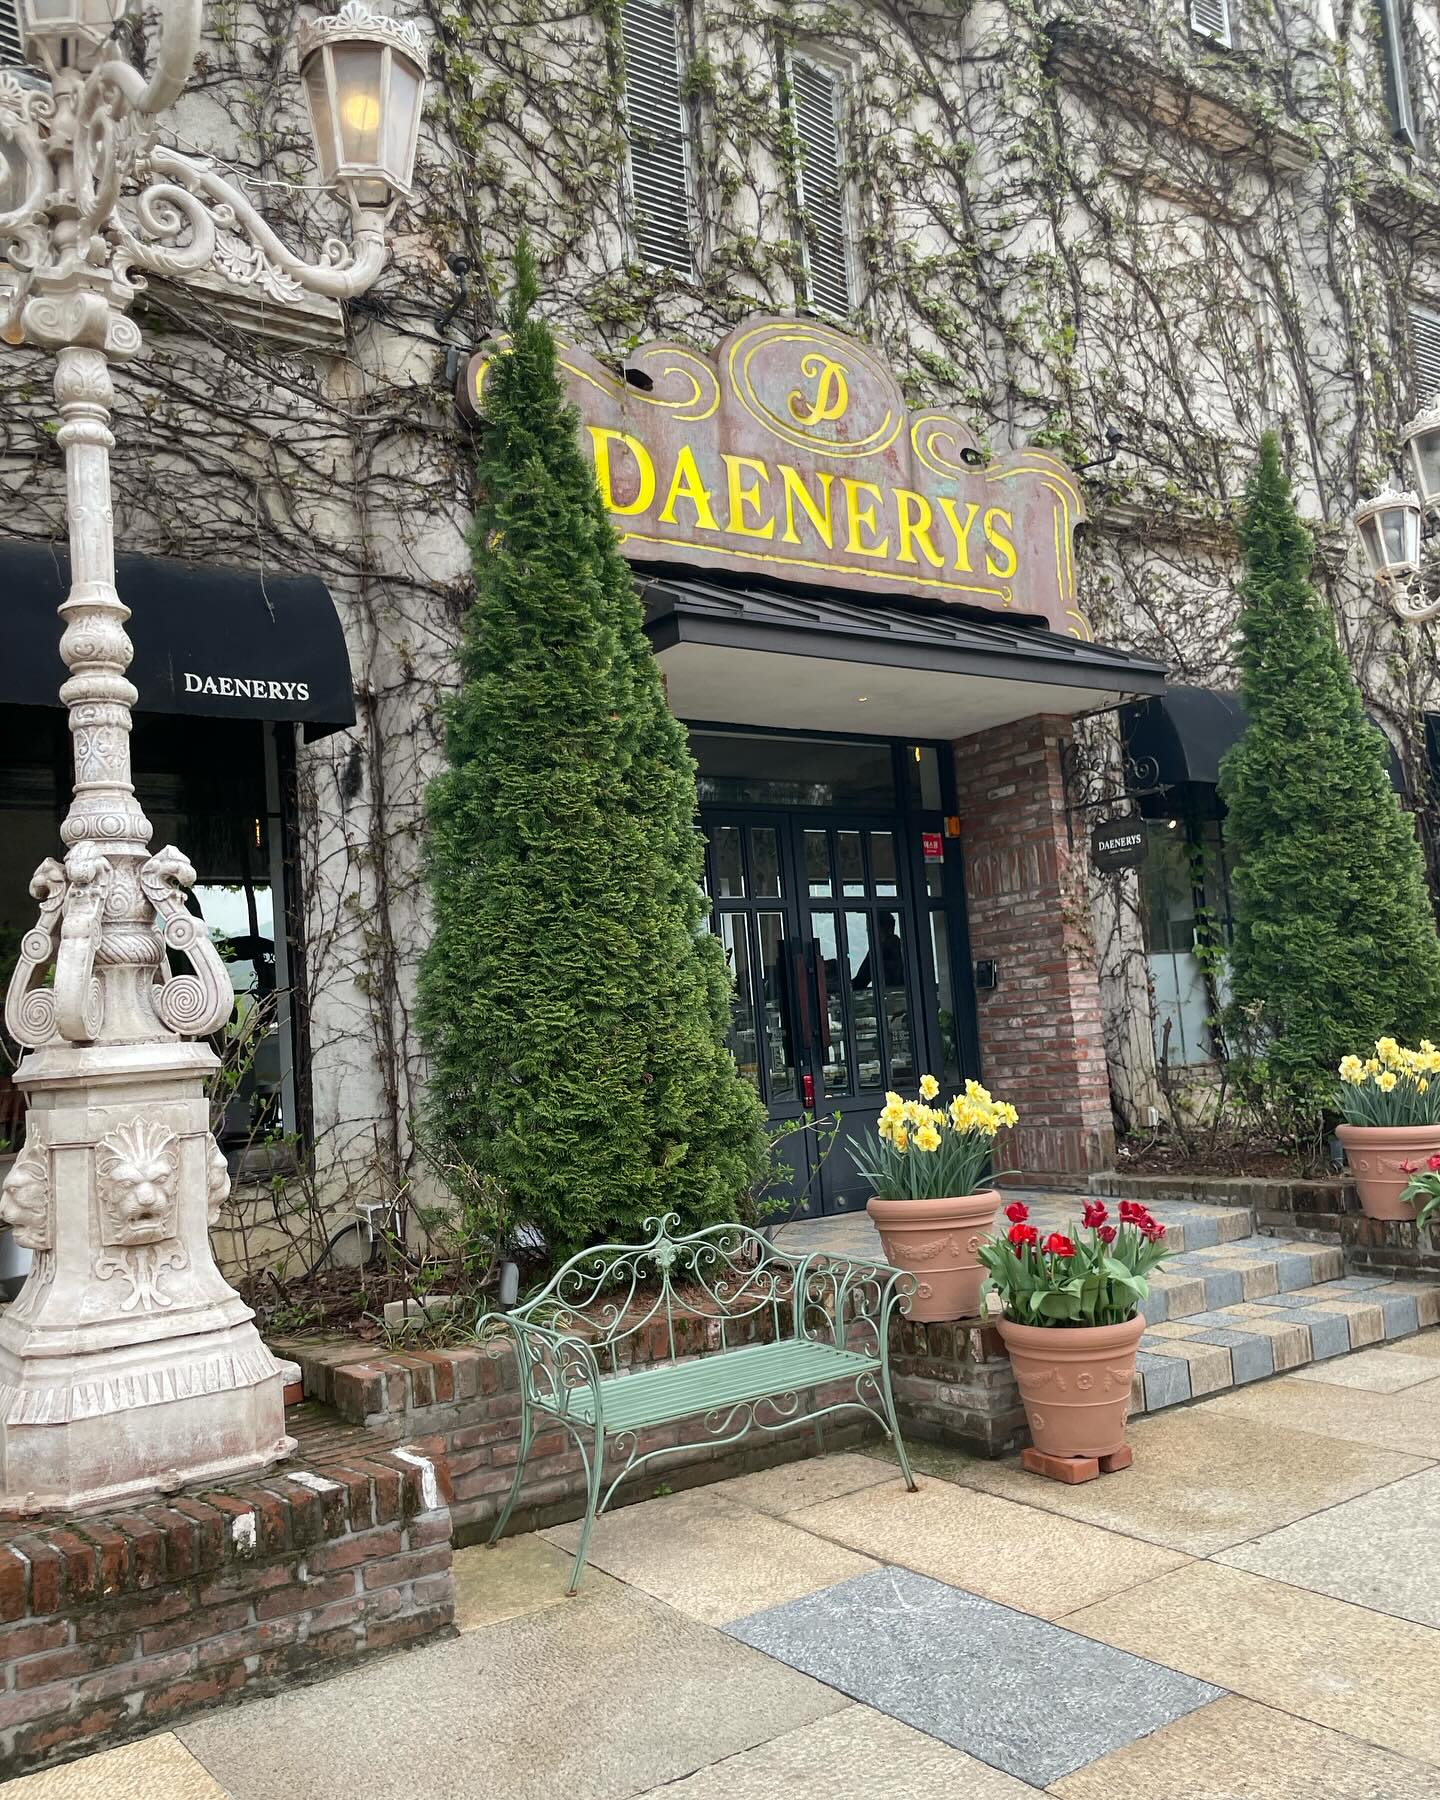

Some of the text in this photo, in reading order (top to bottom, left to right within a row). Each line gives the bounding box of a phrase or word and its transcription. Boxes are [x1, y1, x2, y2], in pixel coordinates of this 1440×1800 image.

[585, 426, 1018, 580] DAENERYS
[183, 672, 310, 701] DAENERYS
[1098, 833, 1142, 852] DAENERYS
